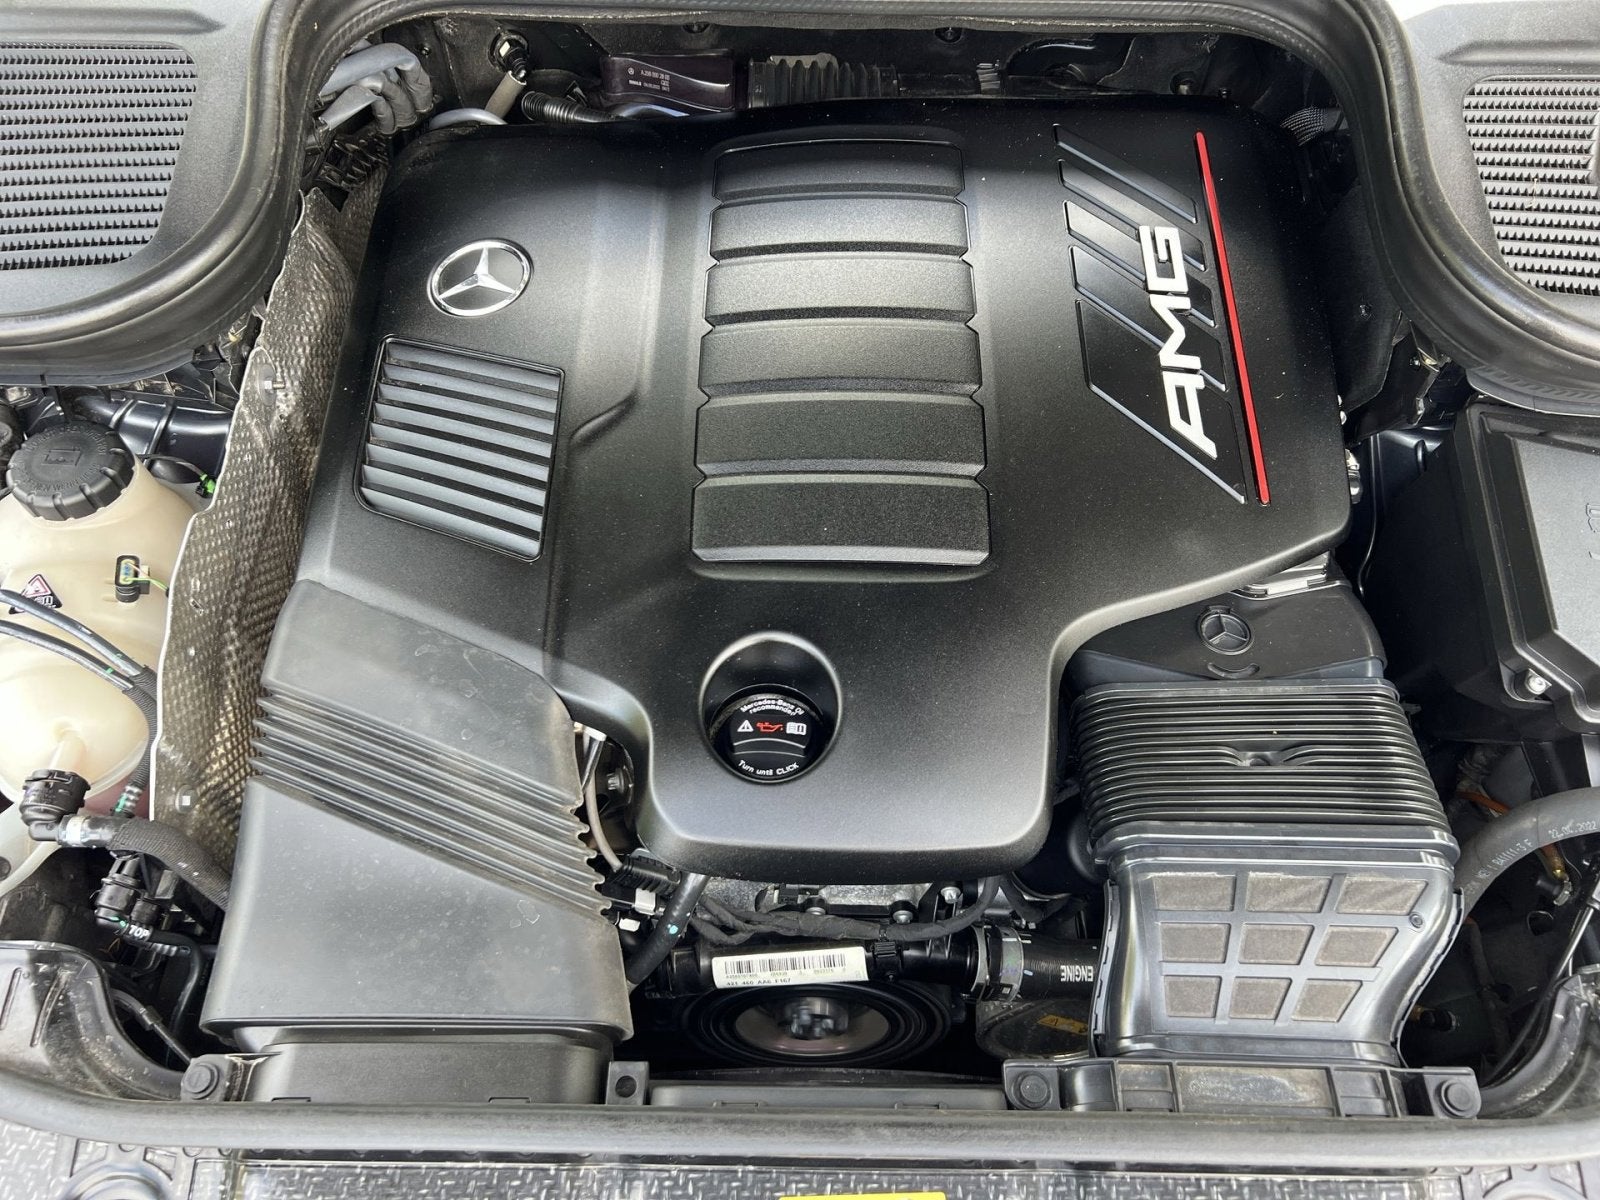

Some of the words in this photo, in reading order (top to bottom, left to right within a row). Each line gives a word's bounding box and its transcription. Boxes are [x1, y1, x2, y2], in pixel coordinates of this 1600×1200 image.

[1138, 225, 1218, 460] AMG
[740, 699, 795, 713] Mercedes-Benz
[738, 760, 755, 773] Turn
[775, 762, 800, 775] CLICK
[128, 924, 150, 940] TOP
[1060, 965, 1094, 982] ENGINE
